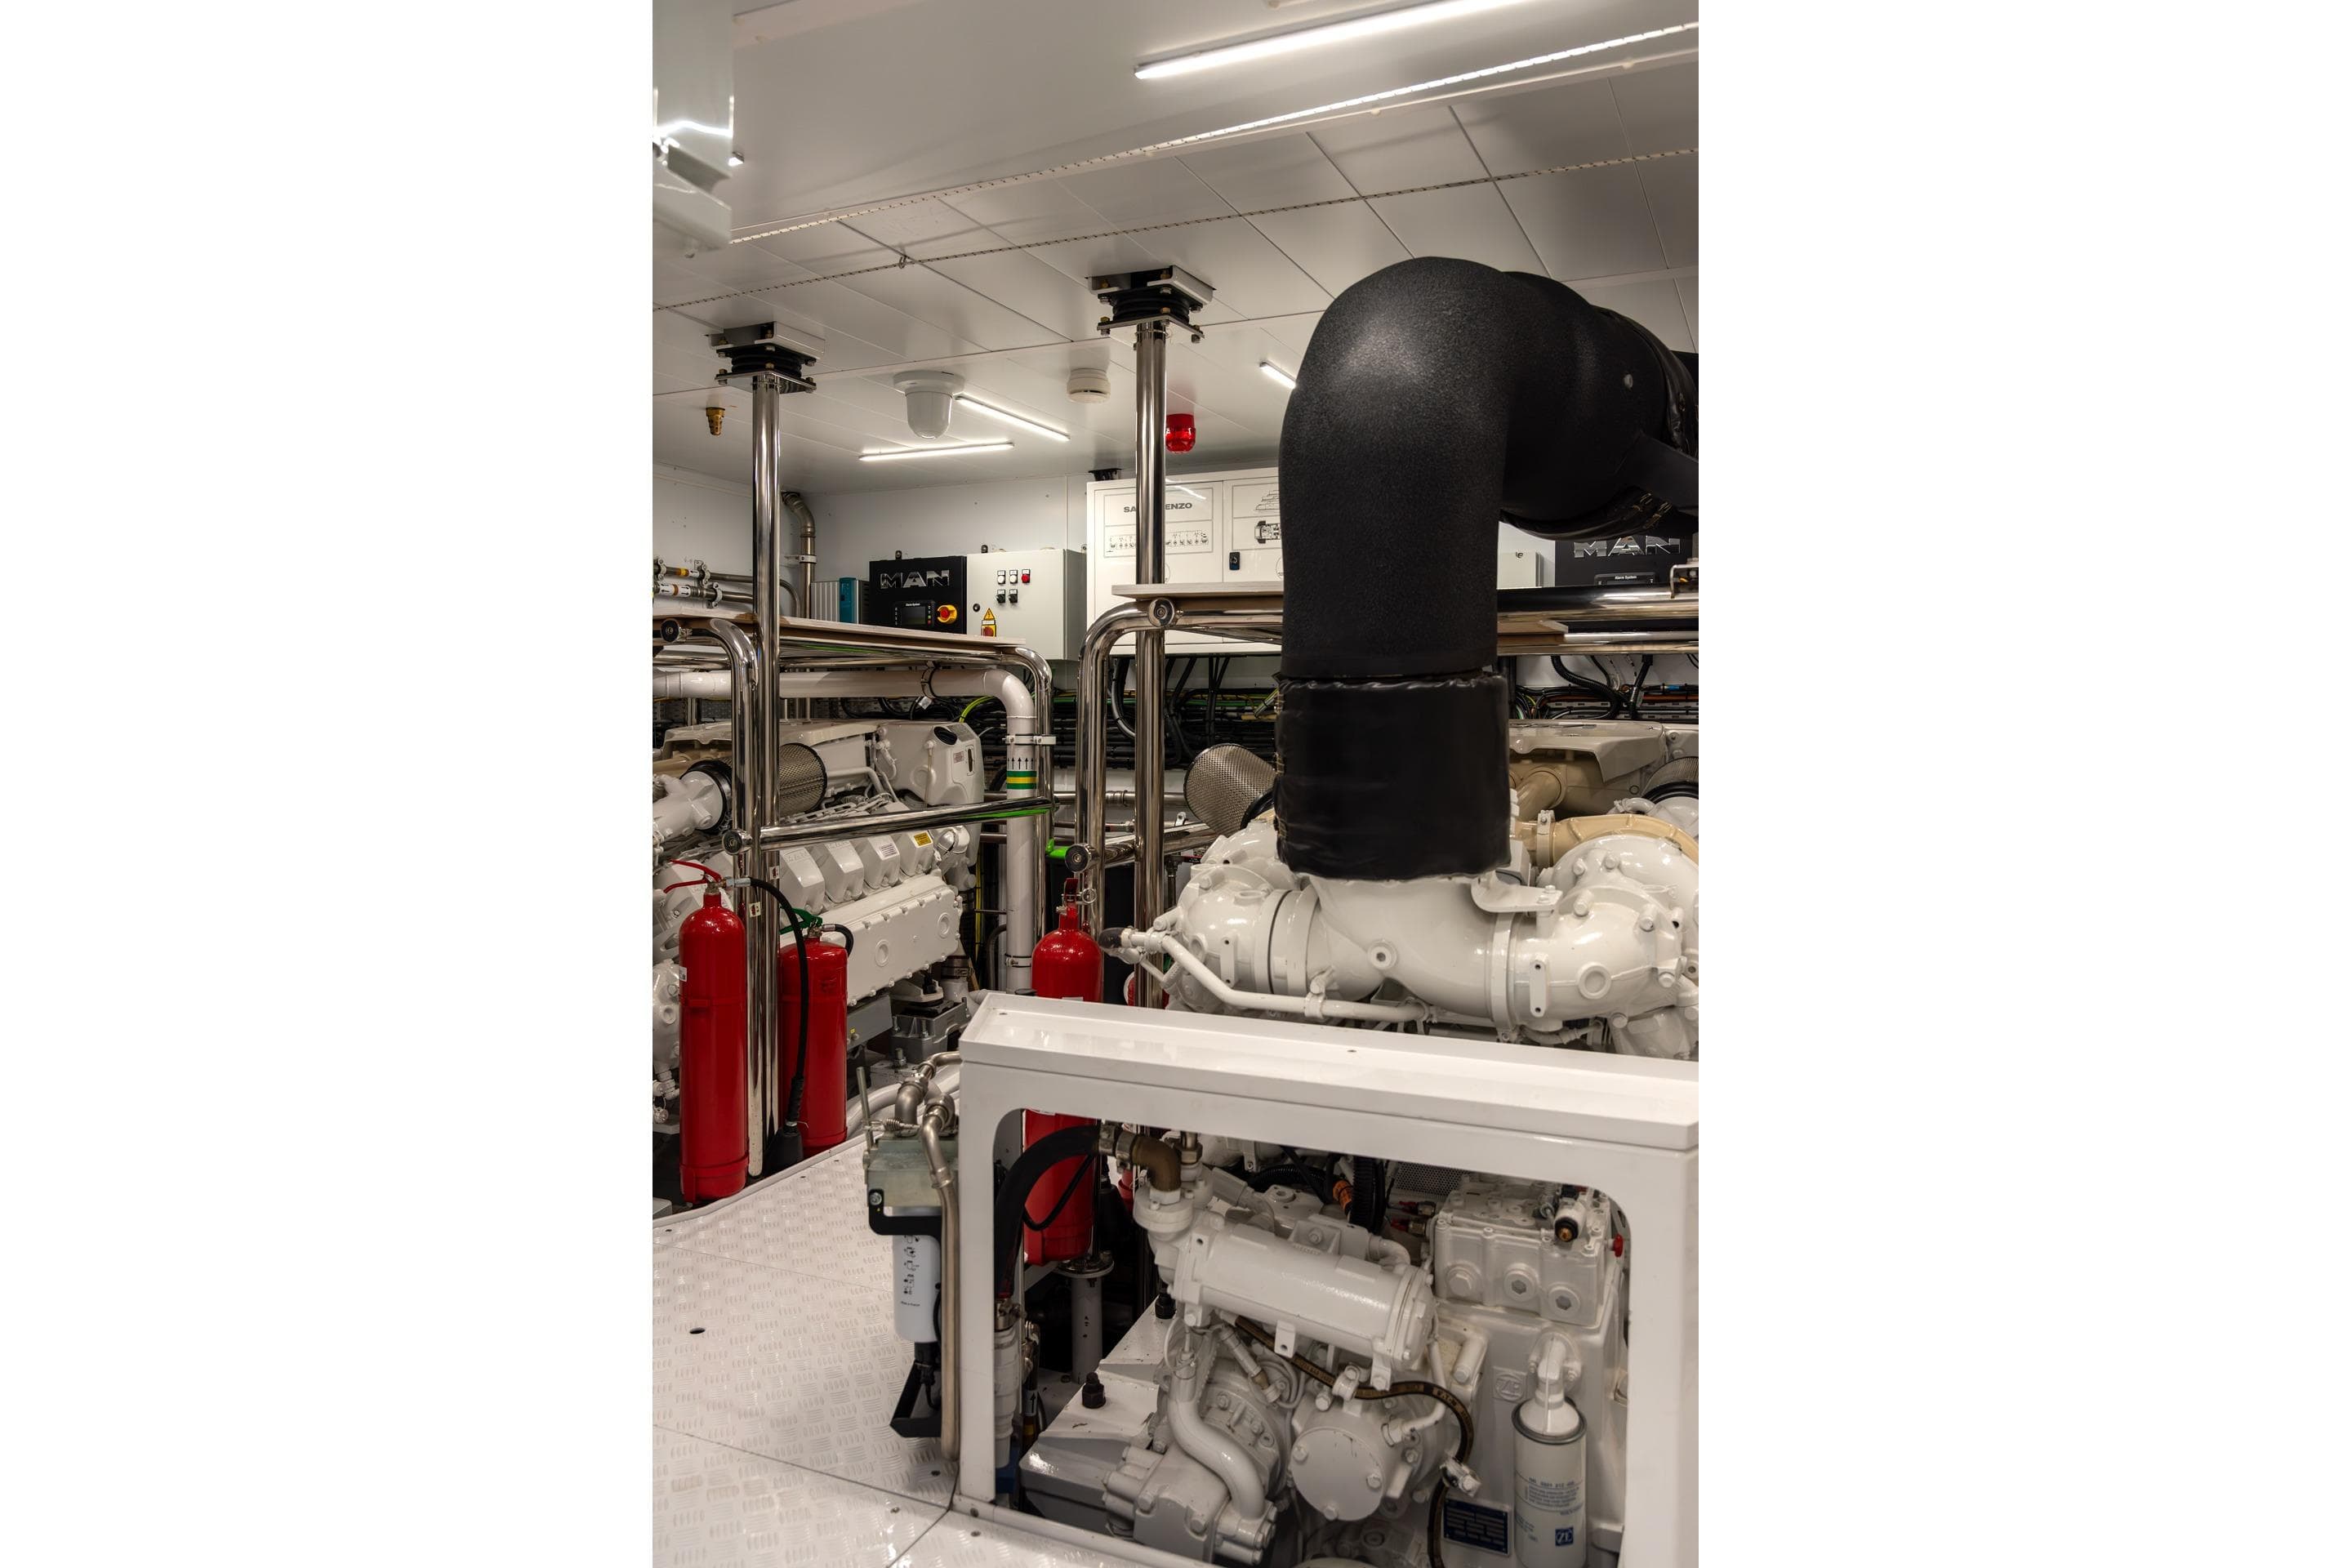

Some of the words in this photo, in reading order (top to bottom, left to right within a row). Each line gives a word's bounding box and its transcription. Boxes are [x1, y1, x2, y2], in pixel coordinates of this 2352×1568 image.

[1124, 502, 1192, 513] SAENZO
[1574, 535, 1681, 558] MAN
[880, 570, 950, 589] MAN
